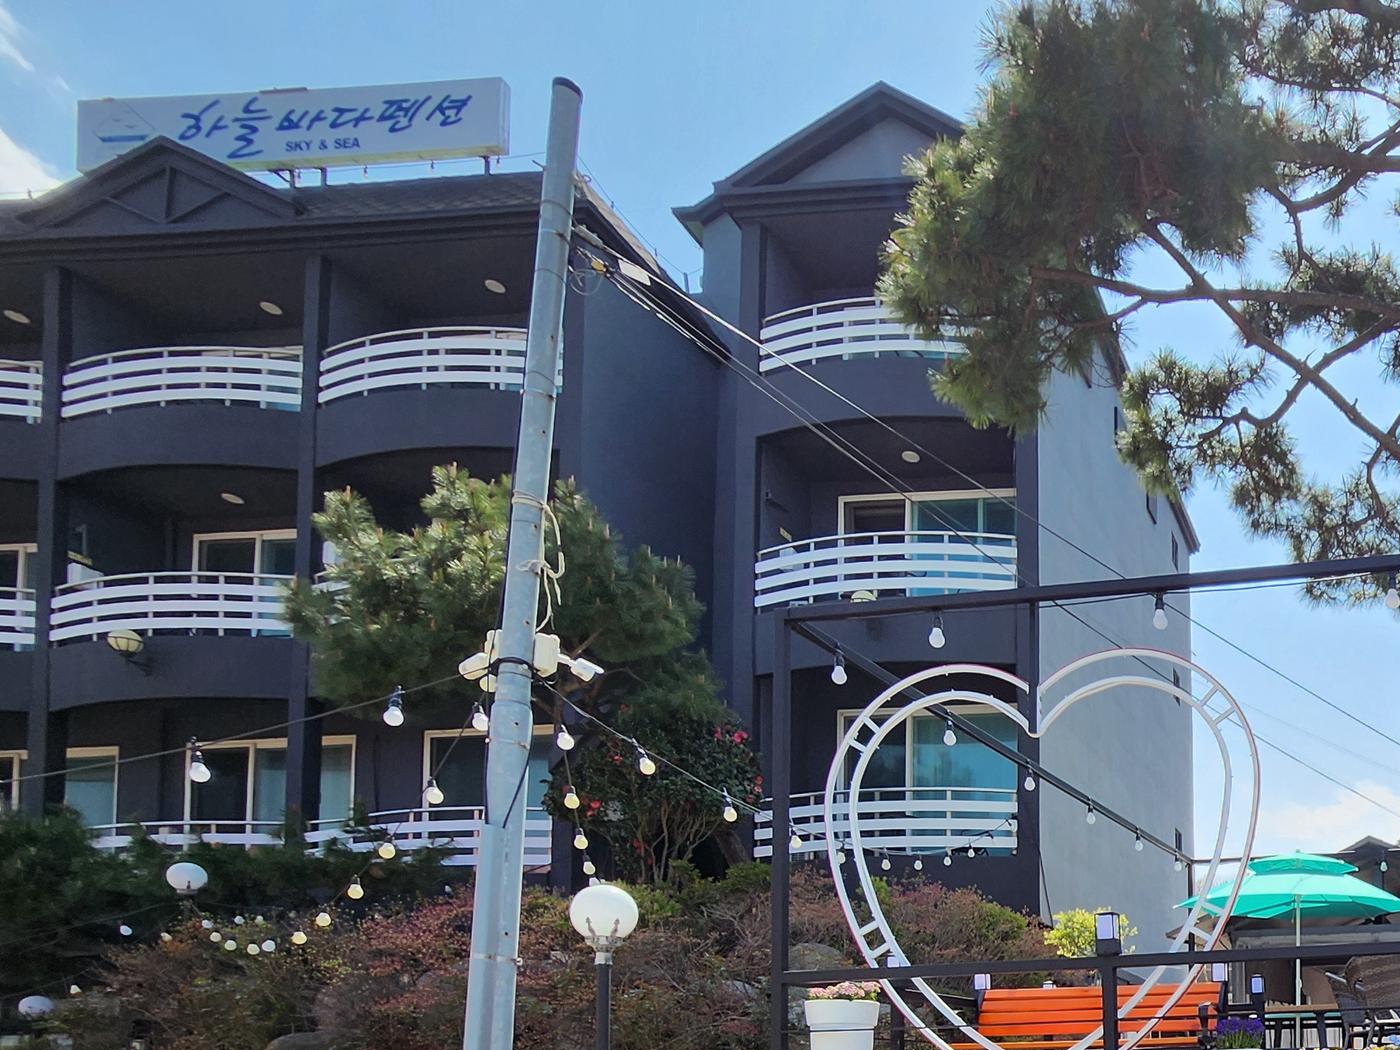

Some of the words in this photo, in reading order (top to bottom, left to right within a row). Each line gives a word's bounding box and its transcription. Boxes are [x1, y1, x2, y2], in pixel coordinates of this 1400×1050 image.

[285, 141, 312, 152] SKY
[319, 139, 328, 150] &
[334, 137, 360, 149] SEA
